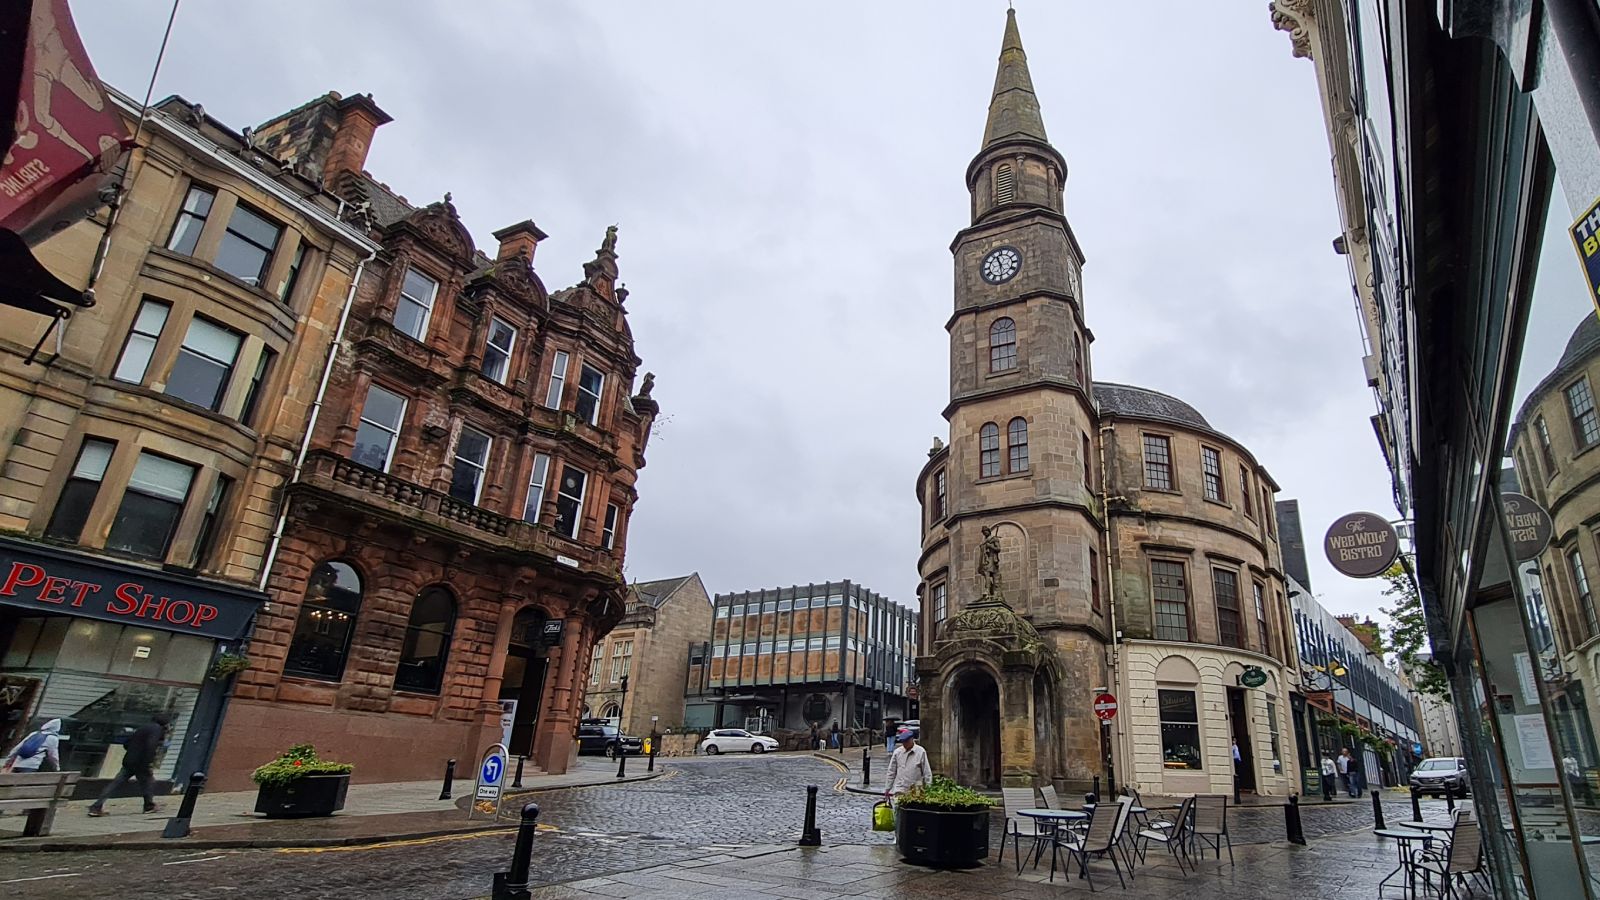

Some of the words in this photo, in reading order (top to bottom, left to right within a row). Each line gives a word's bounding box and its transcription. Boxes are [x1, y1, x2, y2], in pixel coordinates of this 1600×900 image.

[1355, 531, 1388, 546] WOLF
[1340, 545, 1383, 561] BISTRO
[0, 562, 101, 607] PET
[107, 583, 218, 627] SHOP
